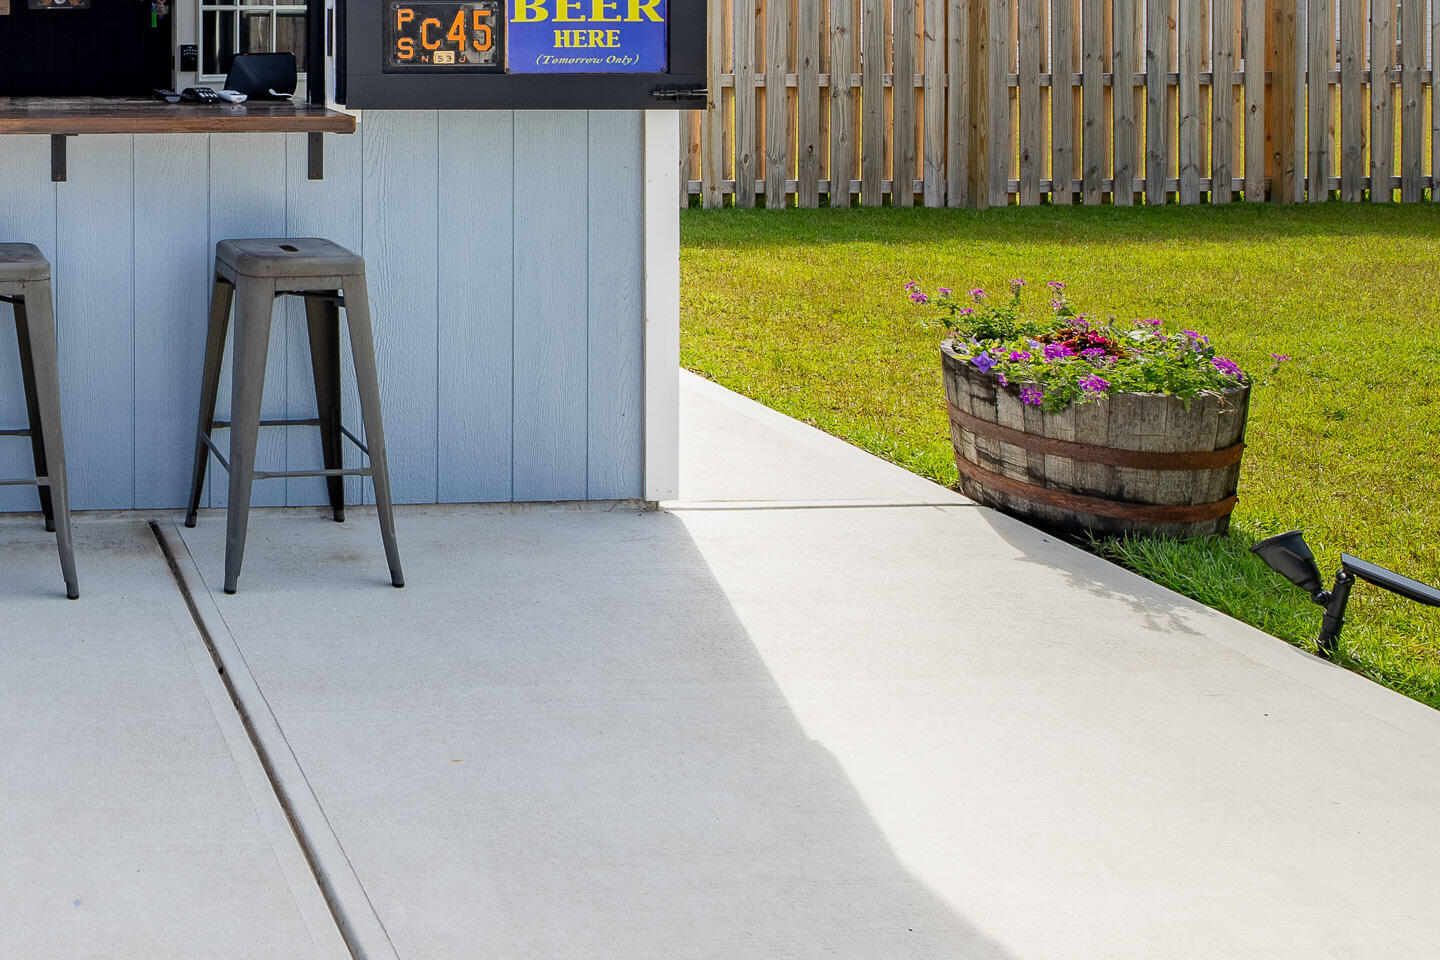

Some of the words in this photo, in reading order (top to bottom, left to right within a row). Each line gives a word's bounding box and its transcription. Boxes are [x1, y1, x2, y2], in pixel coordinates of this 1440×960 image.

[553, 29, 621, 48] HERE
[536, 54, 604, 65] (Tomorrow
[605, 54, 640, 65] Only)
